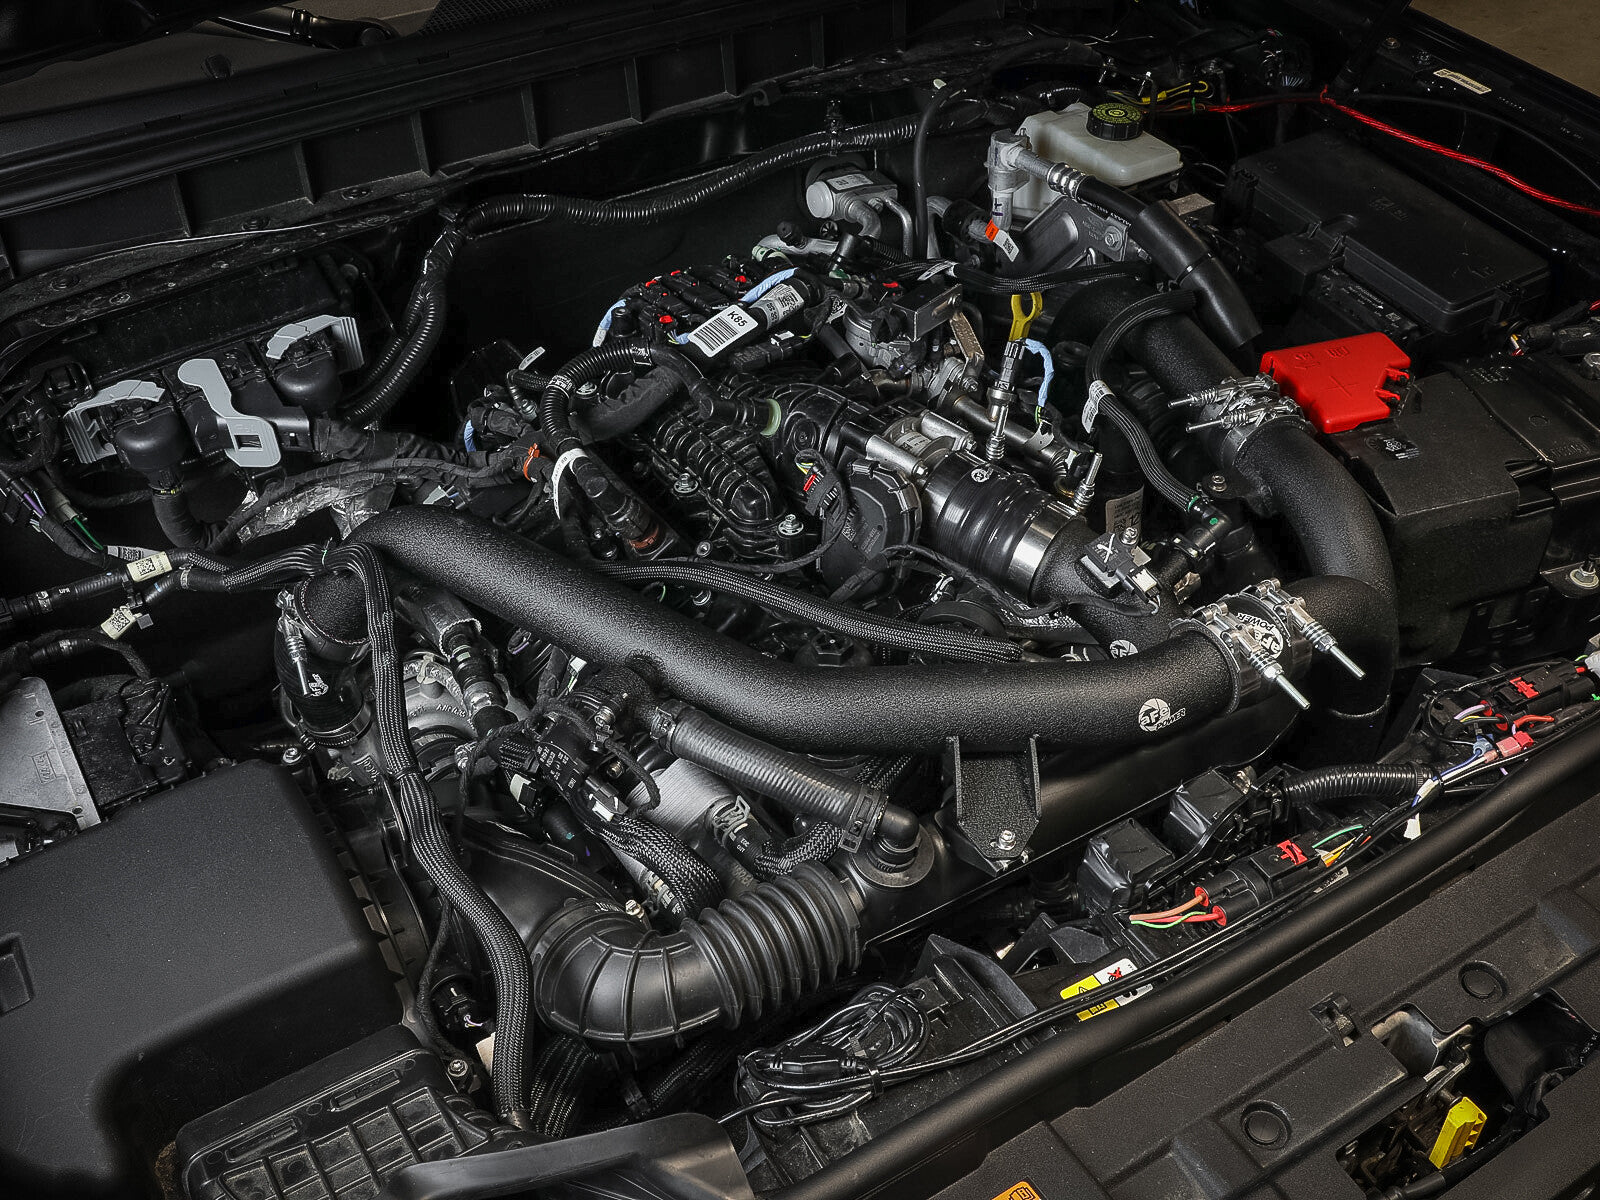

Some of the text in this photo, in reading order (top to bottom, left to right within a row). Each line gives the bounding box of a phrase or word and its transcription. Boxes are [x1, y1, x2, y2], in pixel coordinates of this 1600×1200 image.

[727, 310, 748, 327] K85
[1235, 612, 1276, 631] POWER
[1140, 704, 1169, 727] aFe
